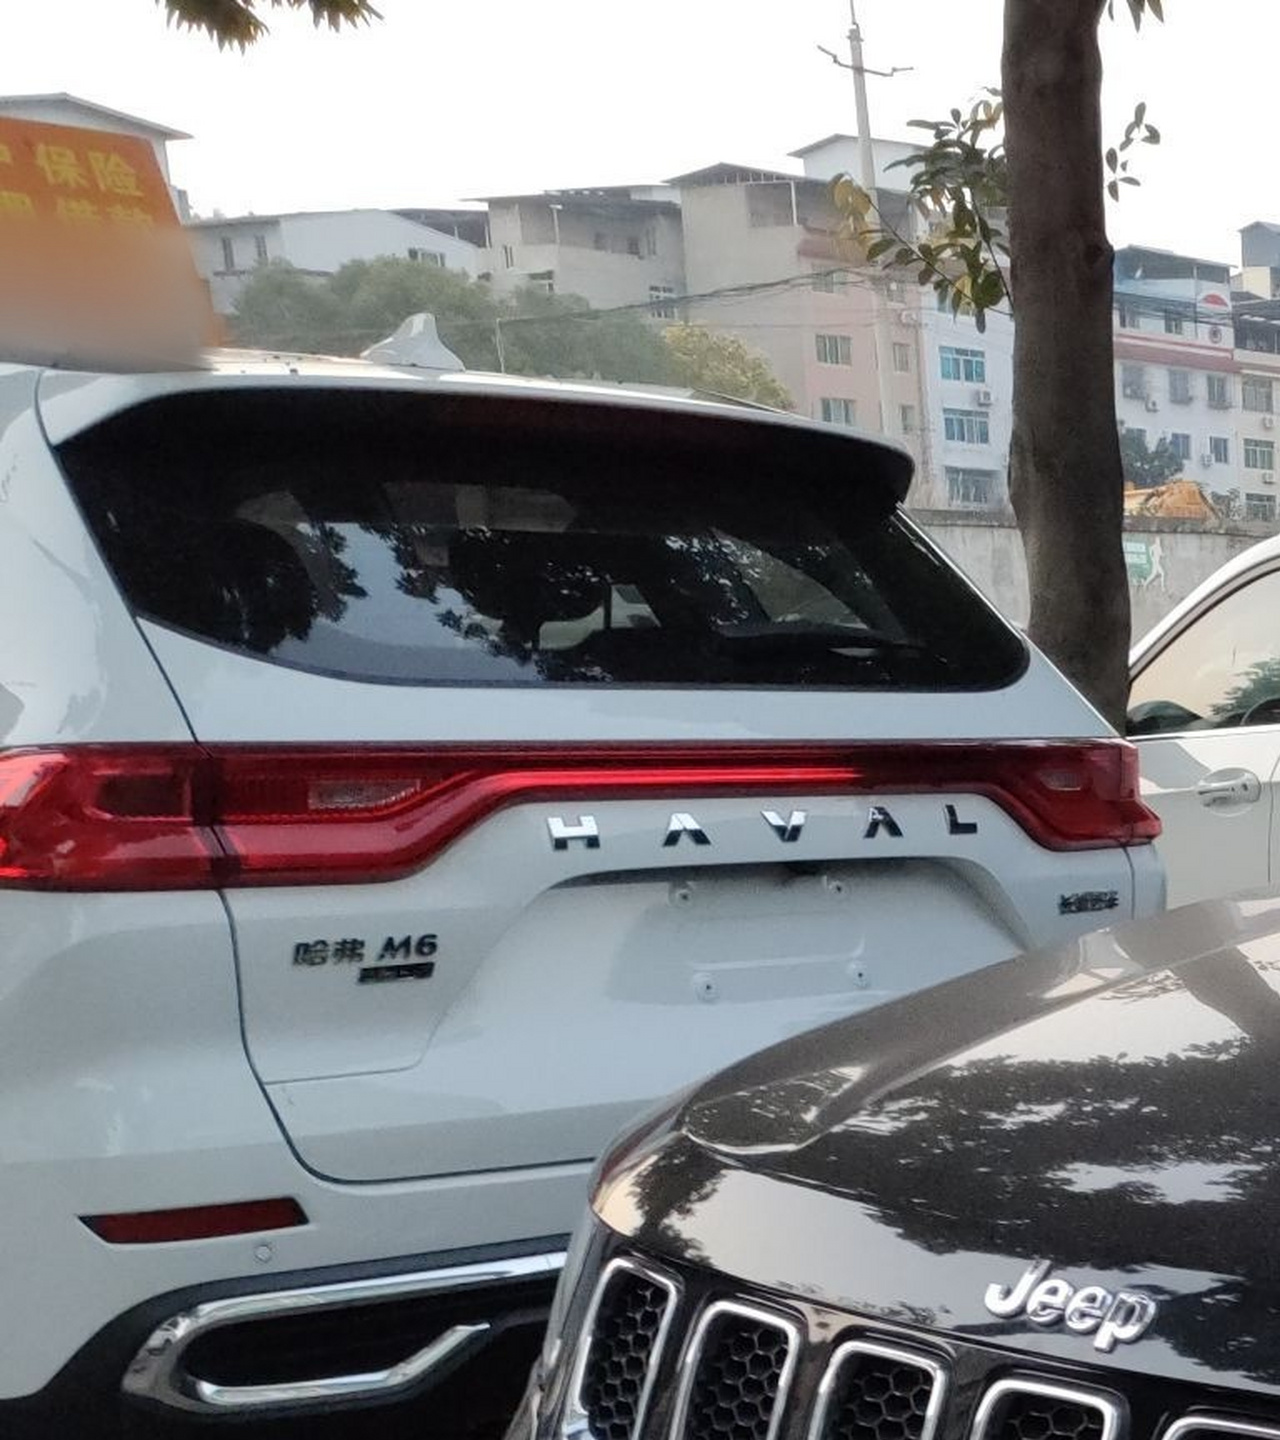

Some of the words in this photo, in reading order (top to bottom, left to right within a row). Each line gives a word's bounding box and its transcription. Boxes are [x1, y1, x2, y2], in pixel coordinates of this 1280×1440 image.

[546, 804, 978, 851] HAVAL
[293, 938, 365, 967] 哈弗
[378, 933, 438, 962] M6
[984, 1258, 1157, 1354] Jeep
